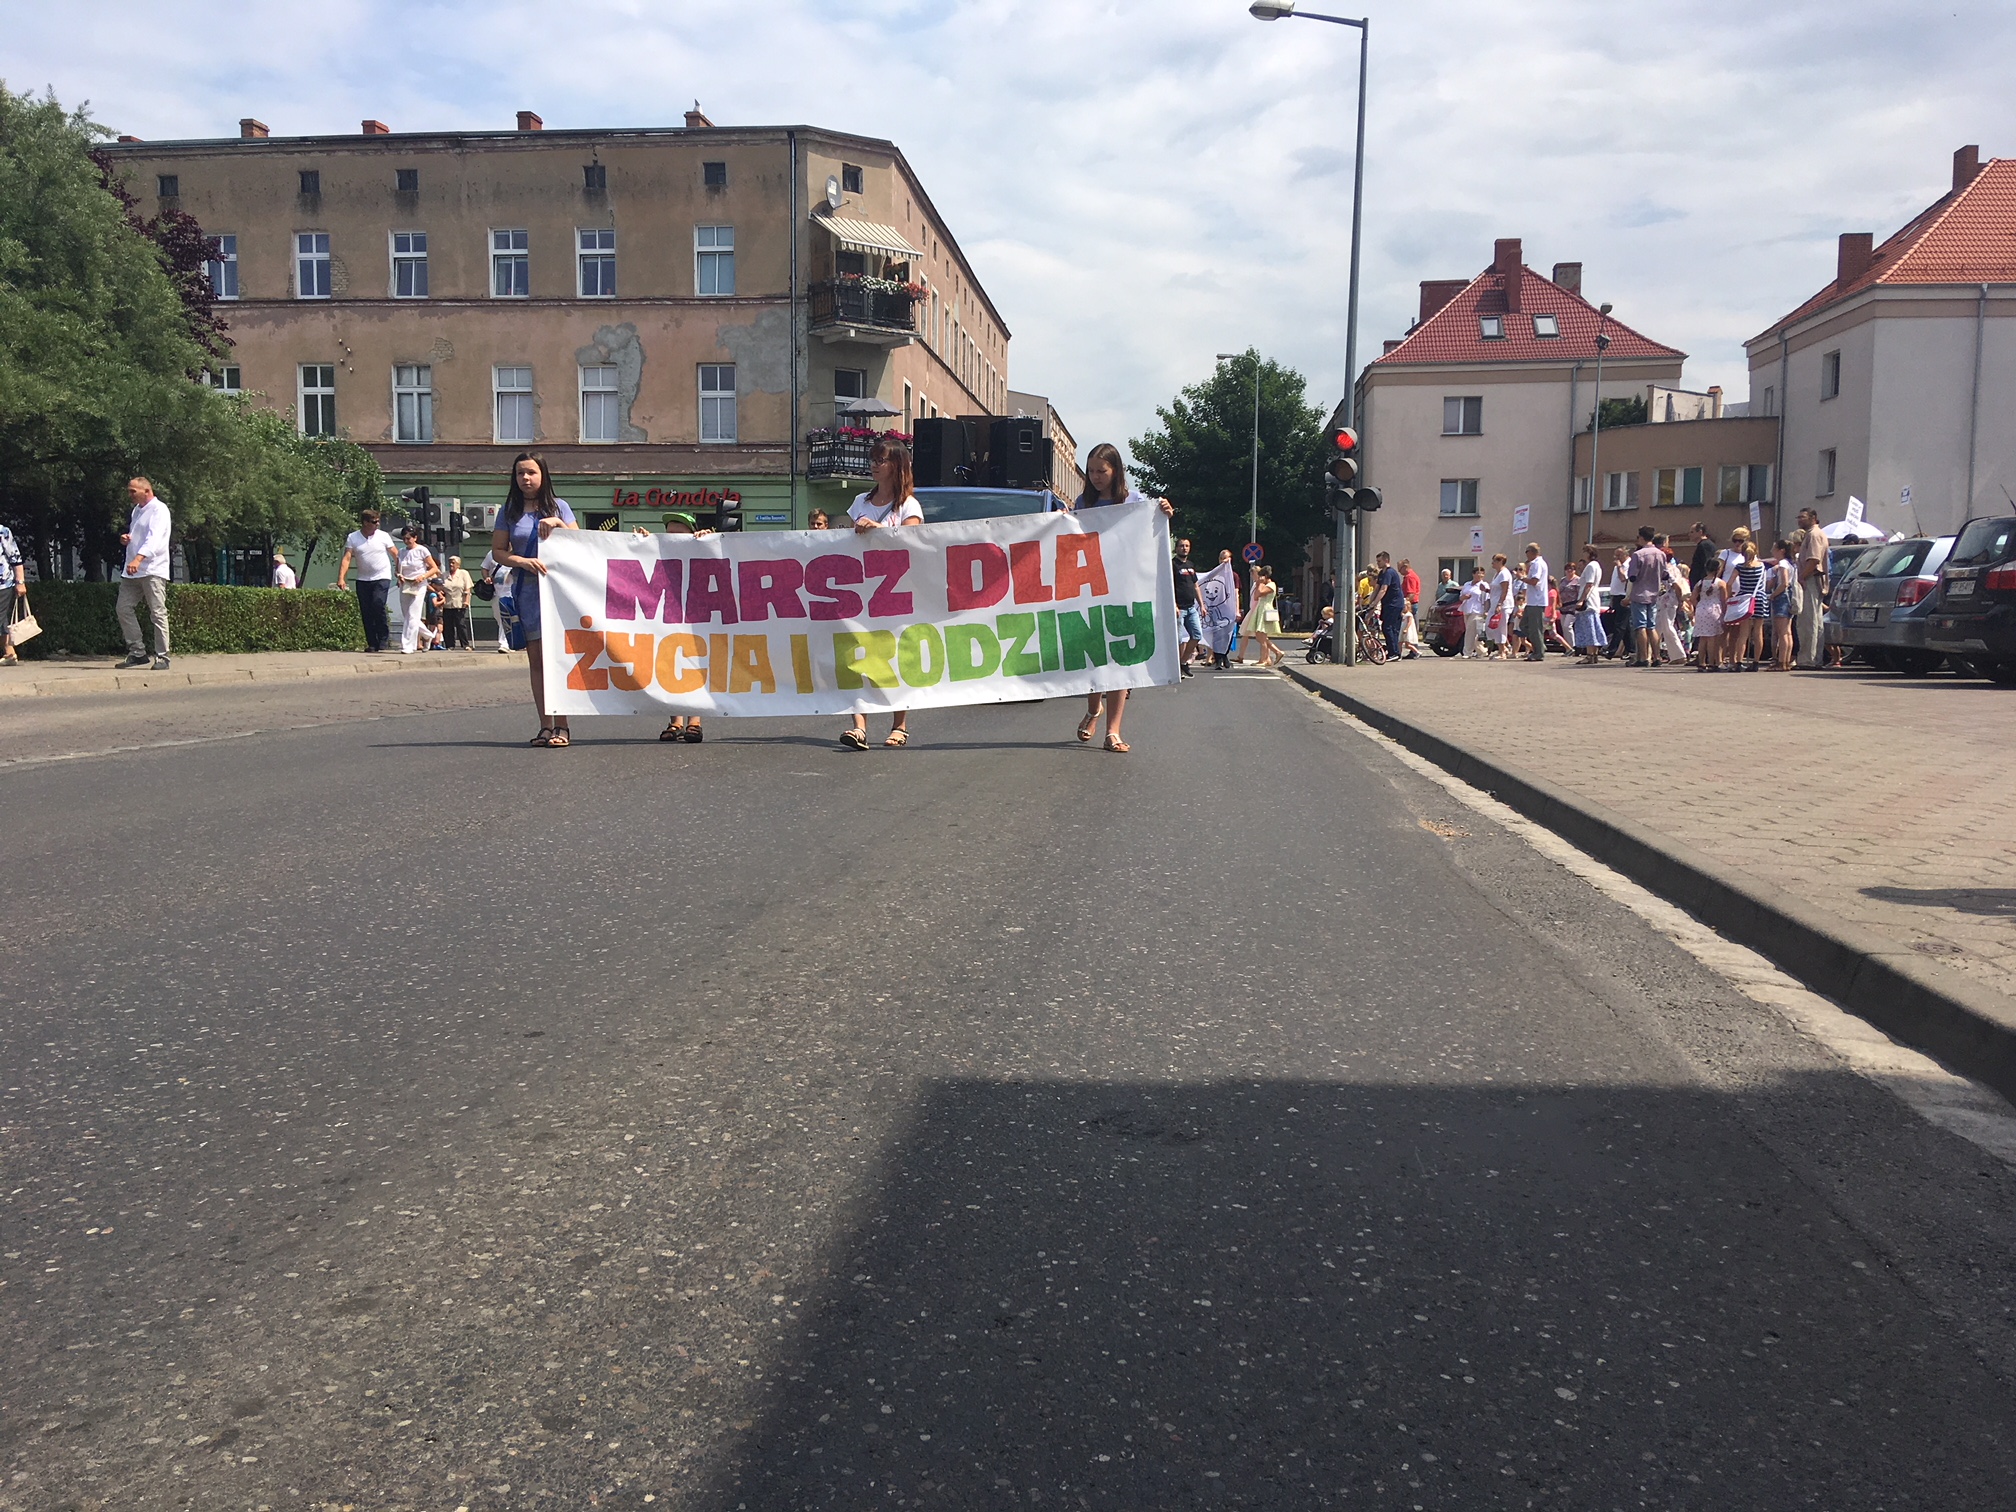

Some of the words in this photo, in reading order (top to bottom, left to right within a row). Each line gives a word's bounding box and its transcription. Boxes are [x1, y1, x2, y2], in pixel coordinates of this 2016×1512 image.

[611, 487, 640, 507] La
[645, 487, 742, 507] Gondola
[605, 549, 914, 625] MARSZ
[946, 531, 1109, 613] DLA
[564, 615, 776, 695] ŻYCIA
[790, 634, 814, 694] I
[833, 601, 1156, 691] RODZINY
